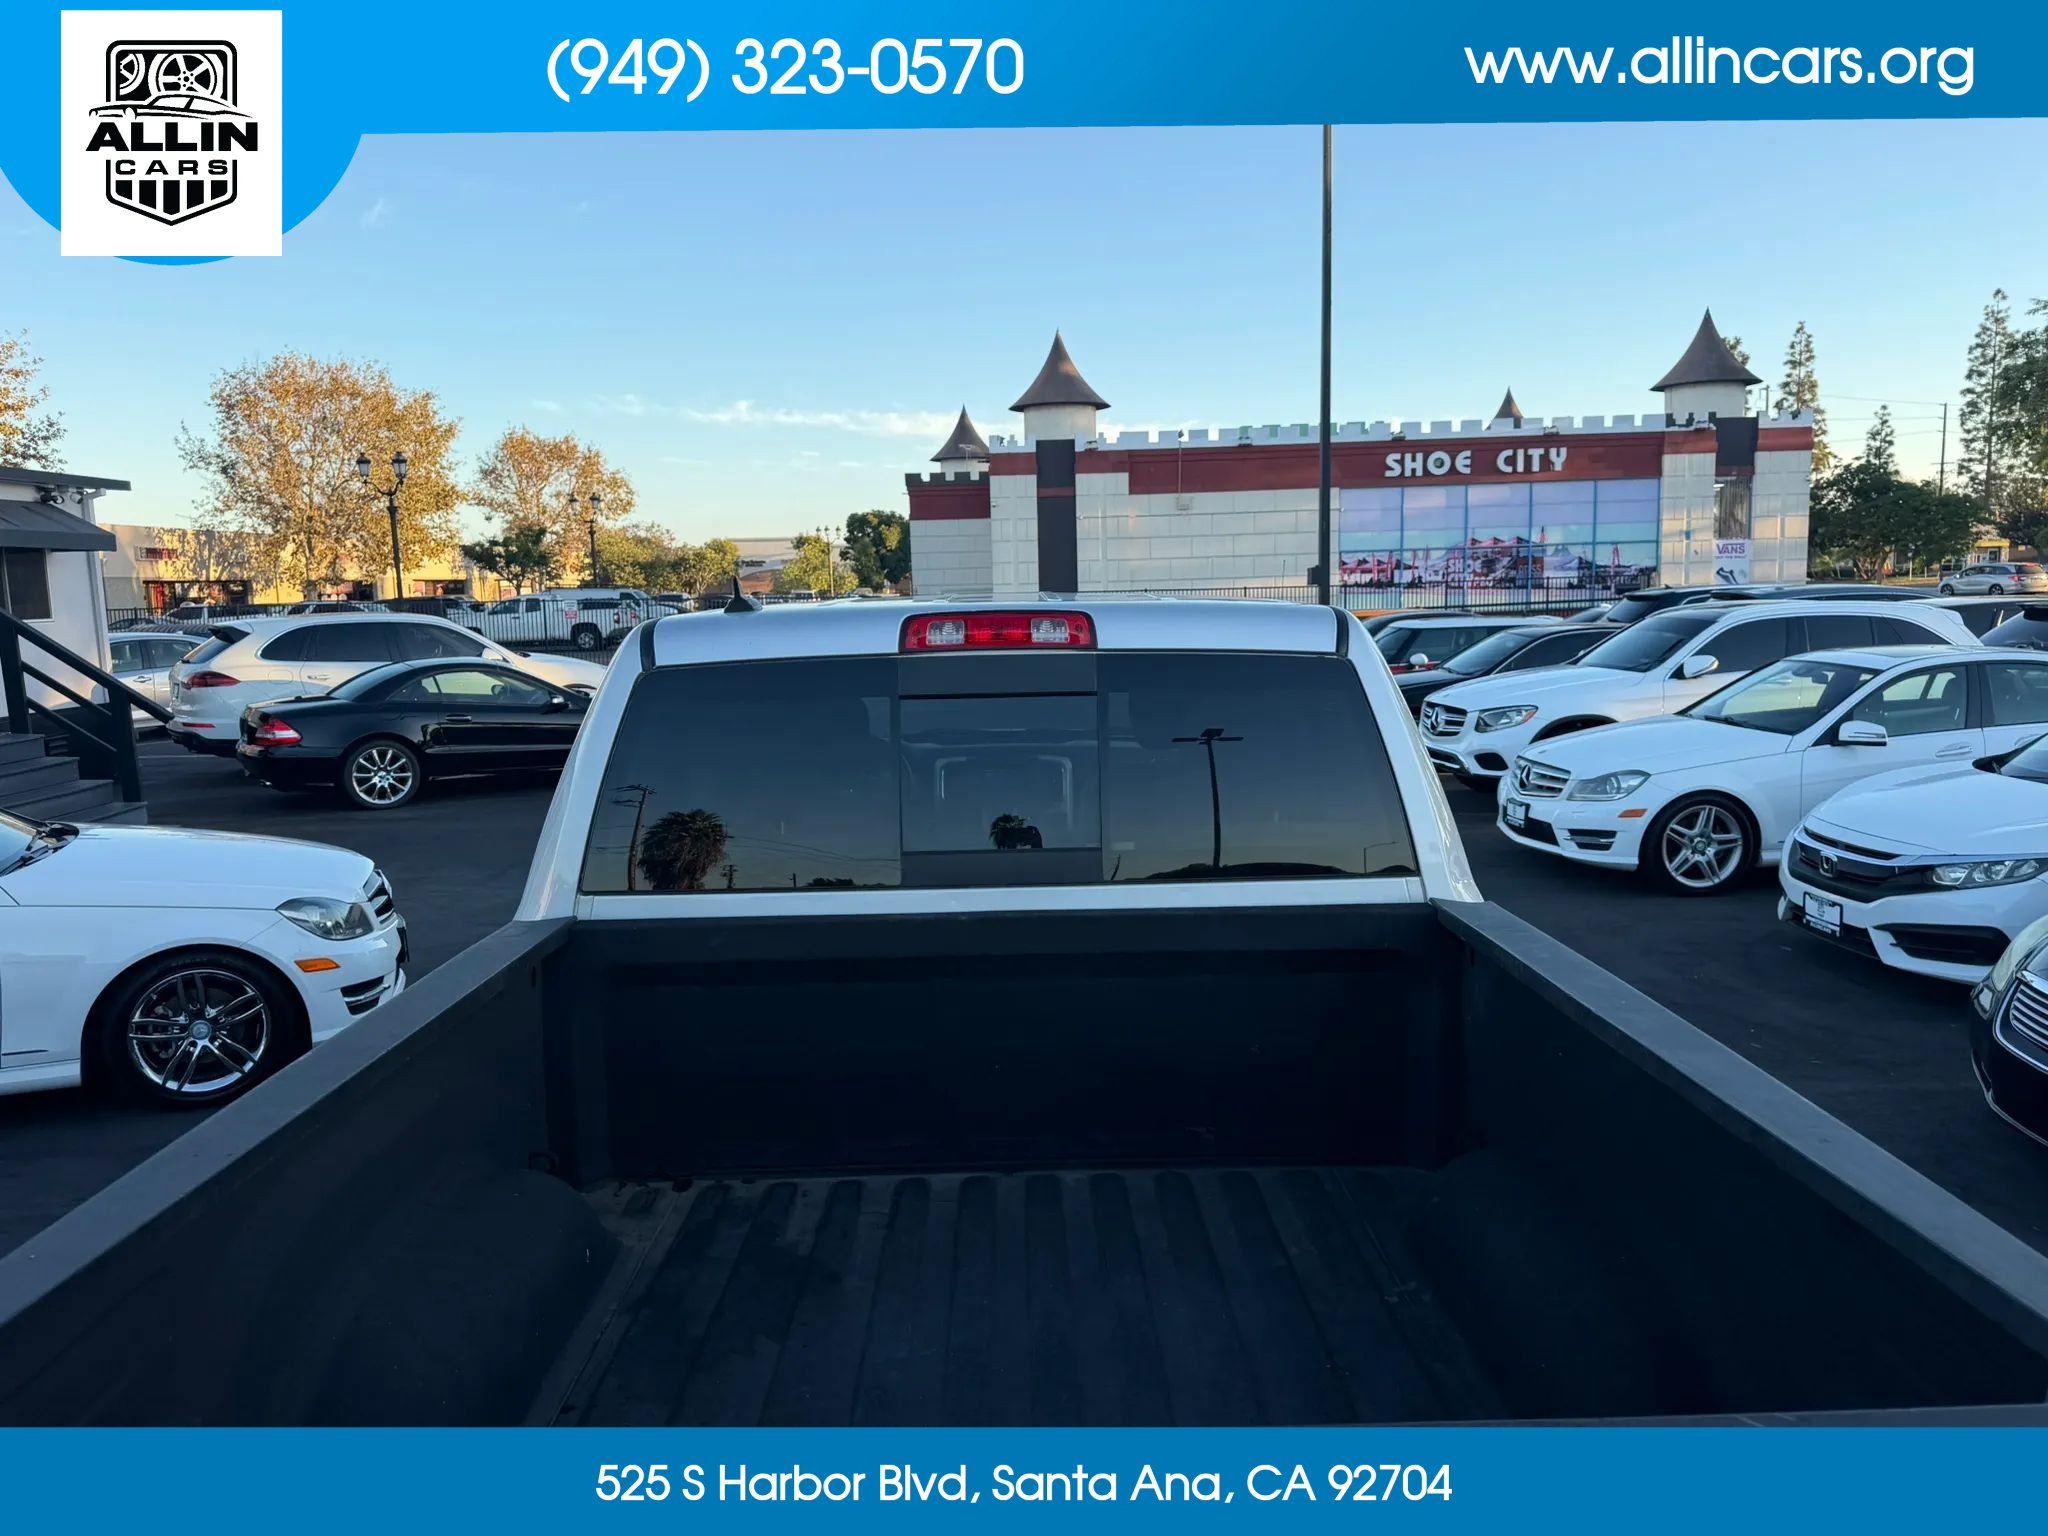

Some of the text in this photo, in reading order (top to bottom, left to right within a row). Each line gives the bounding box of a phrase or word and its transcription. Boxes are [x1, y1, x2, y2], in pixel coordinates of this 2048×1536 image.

[1384, 447, 1568, 477] SHOE CITY
[1716, 542, 1746, 555] VANS
